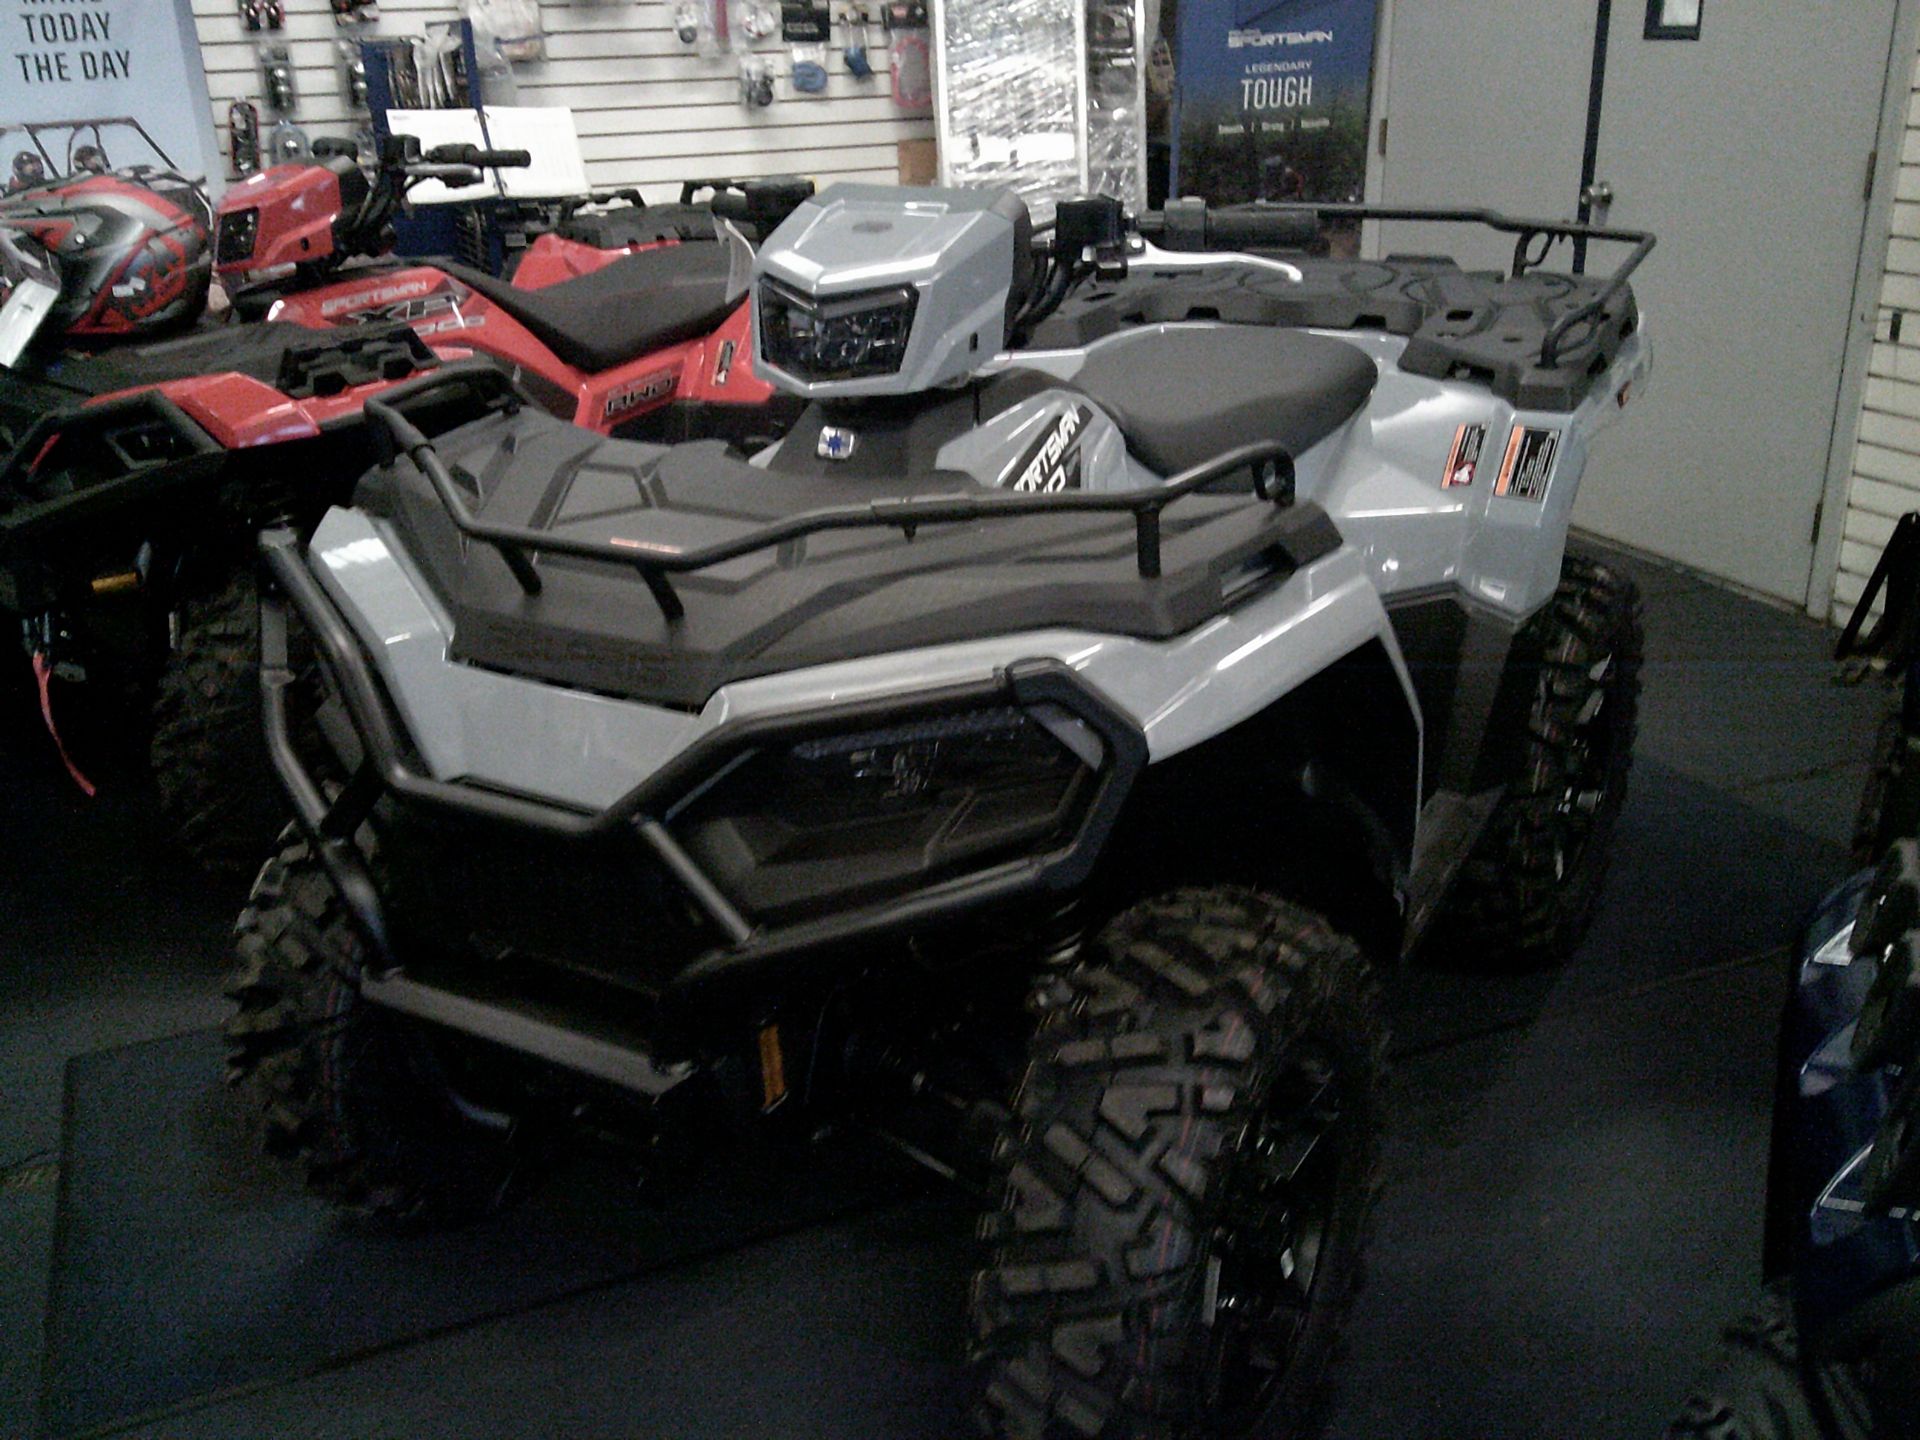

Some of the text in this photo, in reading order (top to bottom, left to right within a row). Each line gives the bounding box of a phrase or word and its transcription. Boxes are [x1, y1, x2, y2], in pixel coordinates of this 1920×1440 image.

[20, 11, 110, 43] TODAY
[14, 50, 130, 83] THE DAY
[1245, 60, 1312, 74] LEGENDARY
[1241, 75, 1312, 110] TOUGH
